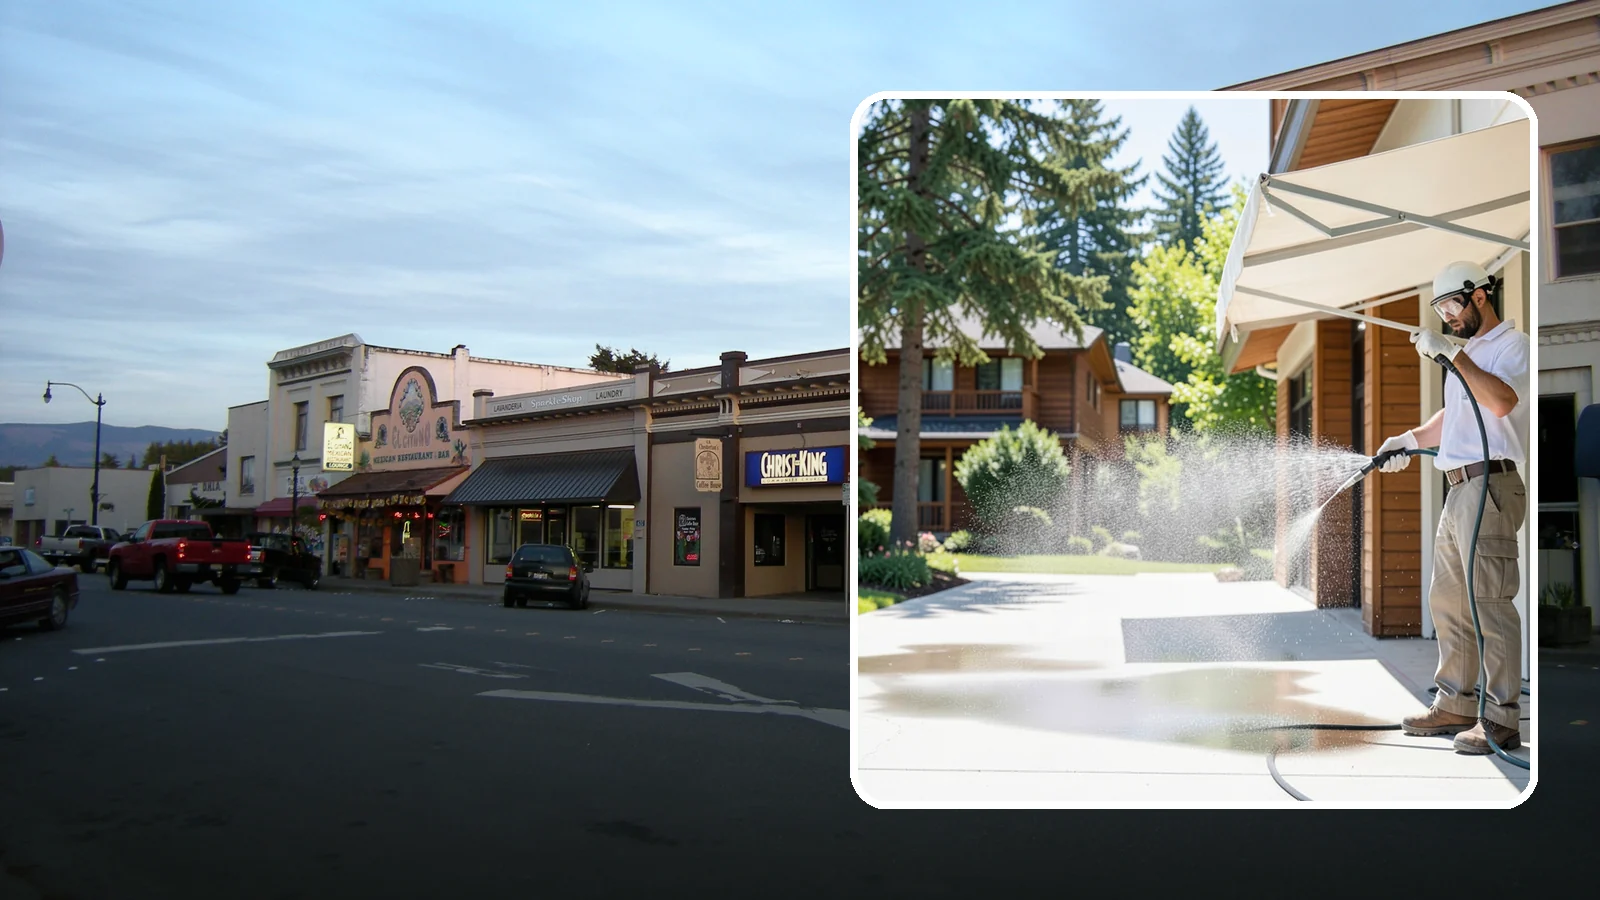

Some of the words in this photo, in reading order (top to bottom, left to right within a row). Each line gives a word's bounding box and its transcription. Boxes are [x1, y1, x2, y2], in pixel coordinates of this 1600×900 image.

[493, 403, 522, 413] LAVANDERIA
[595, 389, 624, 400] LAUNDRY
[373, 454, 396, 464] MEXICAN
[397, 451, 434, 462] RESTAURANT
[437, 449, 450, 459] BAR
[799, 450, 827, 476] KING
[696, 480, 709, 489] Coffee
[709, 480, 722, 489] House
